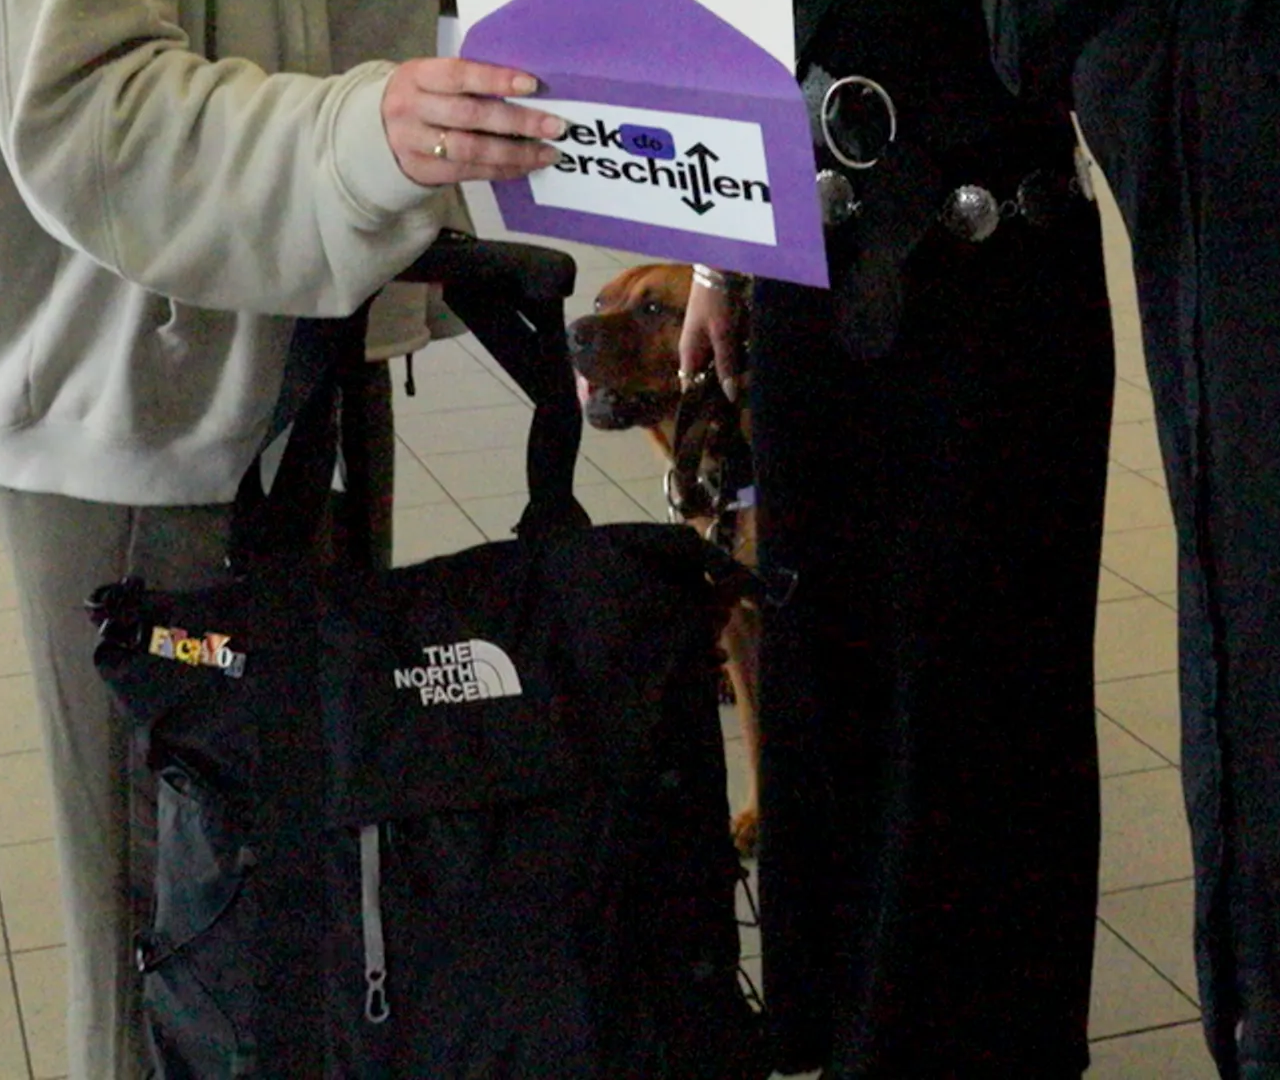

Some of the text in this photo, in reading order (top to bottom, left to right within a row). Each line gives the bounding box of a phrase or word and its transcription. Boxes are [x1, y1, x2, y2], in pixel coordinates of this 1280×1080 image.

[422, 642, 471, 665] THE
[393, 662, 474, 689] NORTH
[421, 682, 480, 707] FACE
